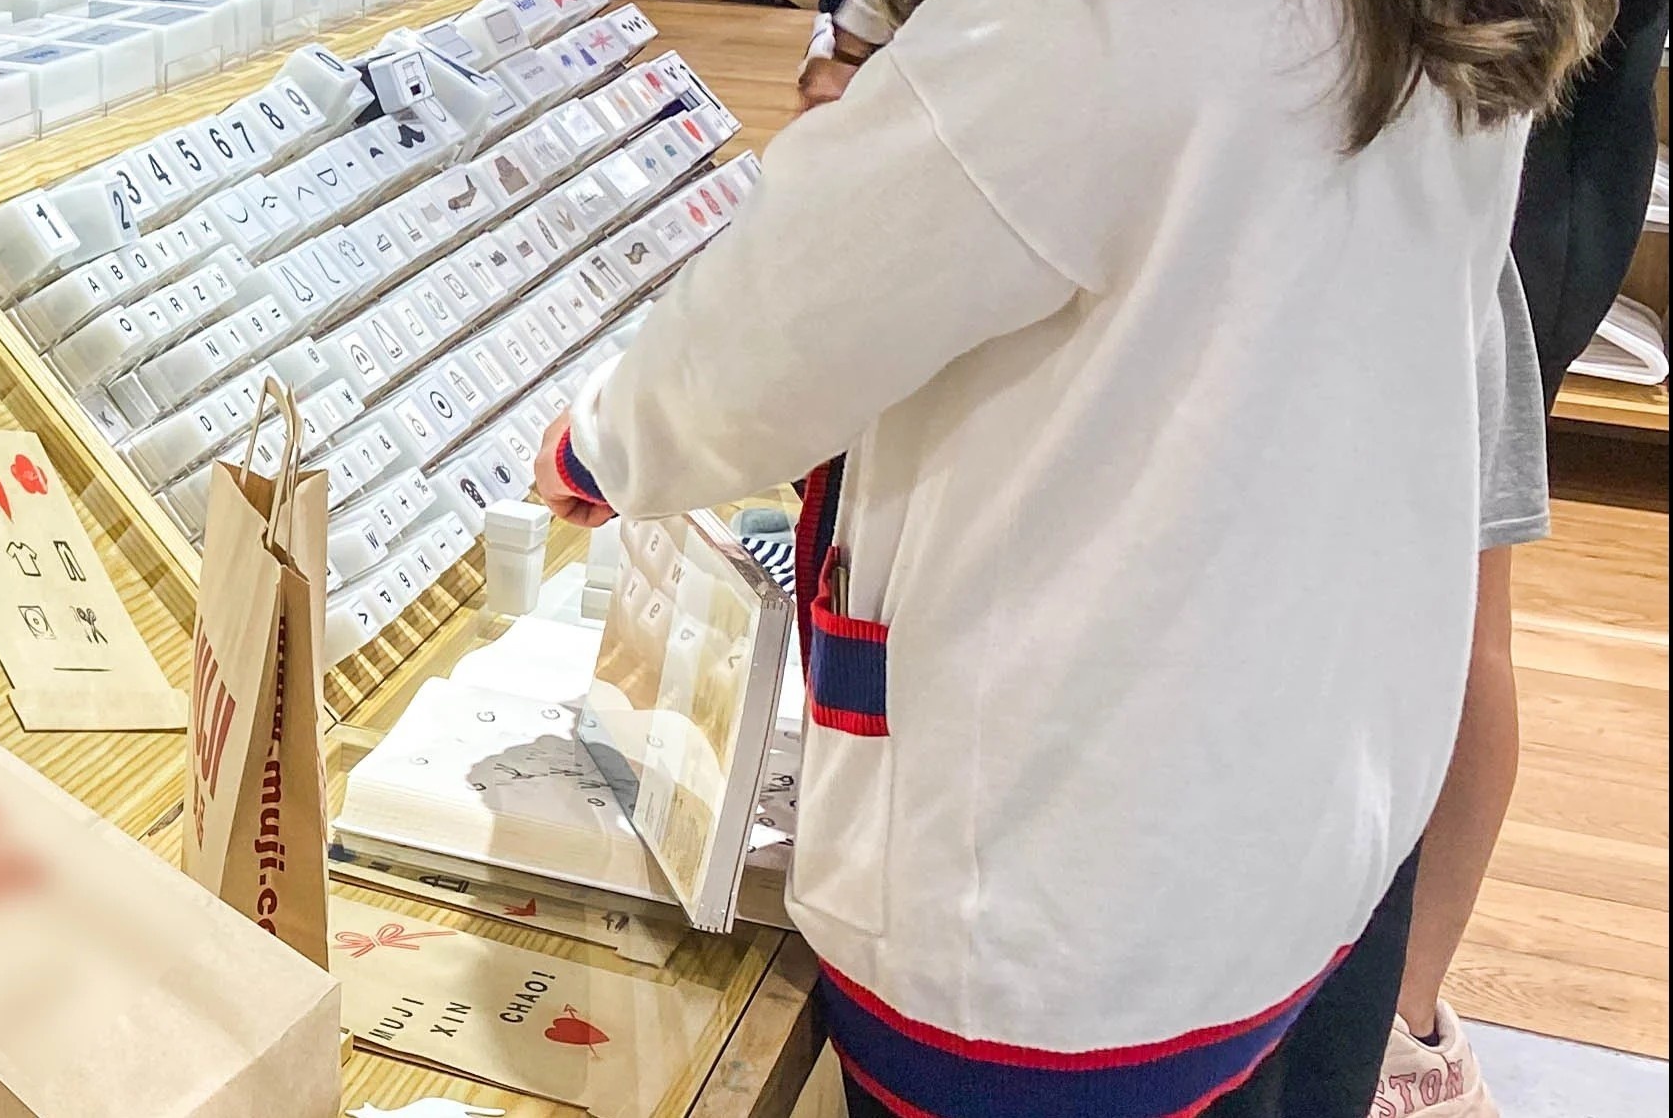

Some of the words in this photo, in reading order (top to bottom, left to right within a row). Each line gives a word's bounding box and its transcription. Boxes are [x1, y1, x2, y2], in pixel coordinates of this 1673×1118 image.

[259, 101, 284, 130] 8
[285, 87, 310, 115] 9
[208, 127, 233, 158] 6
[232, 121, 255, 153] 7
[147, 153, 172, 185] 4
[177, 138, 202, 172] 5
[117, 170, 142, 204] 3
[36, 203, 62, 238] 1
[113, 186, 131, 230] 2
[87, 277, 100, 292] A
[110, 265, 124, 280] B
[155, 241, 168, 257] Y
[200, 220, 212, 233] X
[169, 297, 182, 312] R
[98, 410, 114, 428] K
[199, 416, 212, 432] D
[224, 402, 237, 417] L
[243, 388, 255, 404] T
[380, 509, 392, 526] 5
[399, 572, 411, 588] 9
[418, 555, 431, 572] X
[499, 970, 556, 1024] CHAO!
[368, 996, 425, 1042] MUJI
[430, 1001, 472, 1037] XIN
